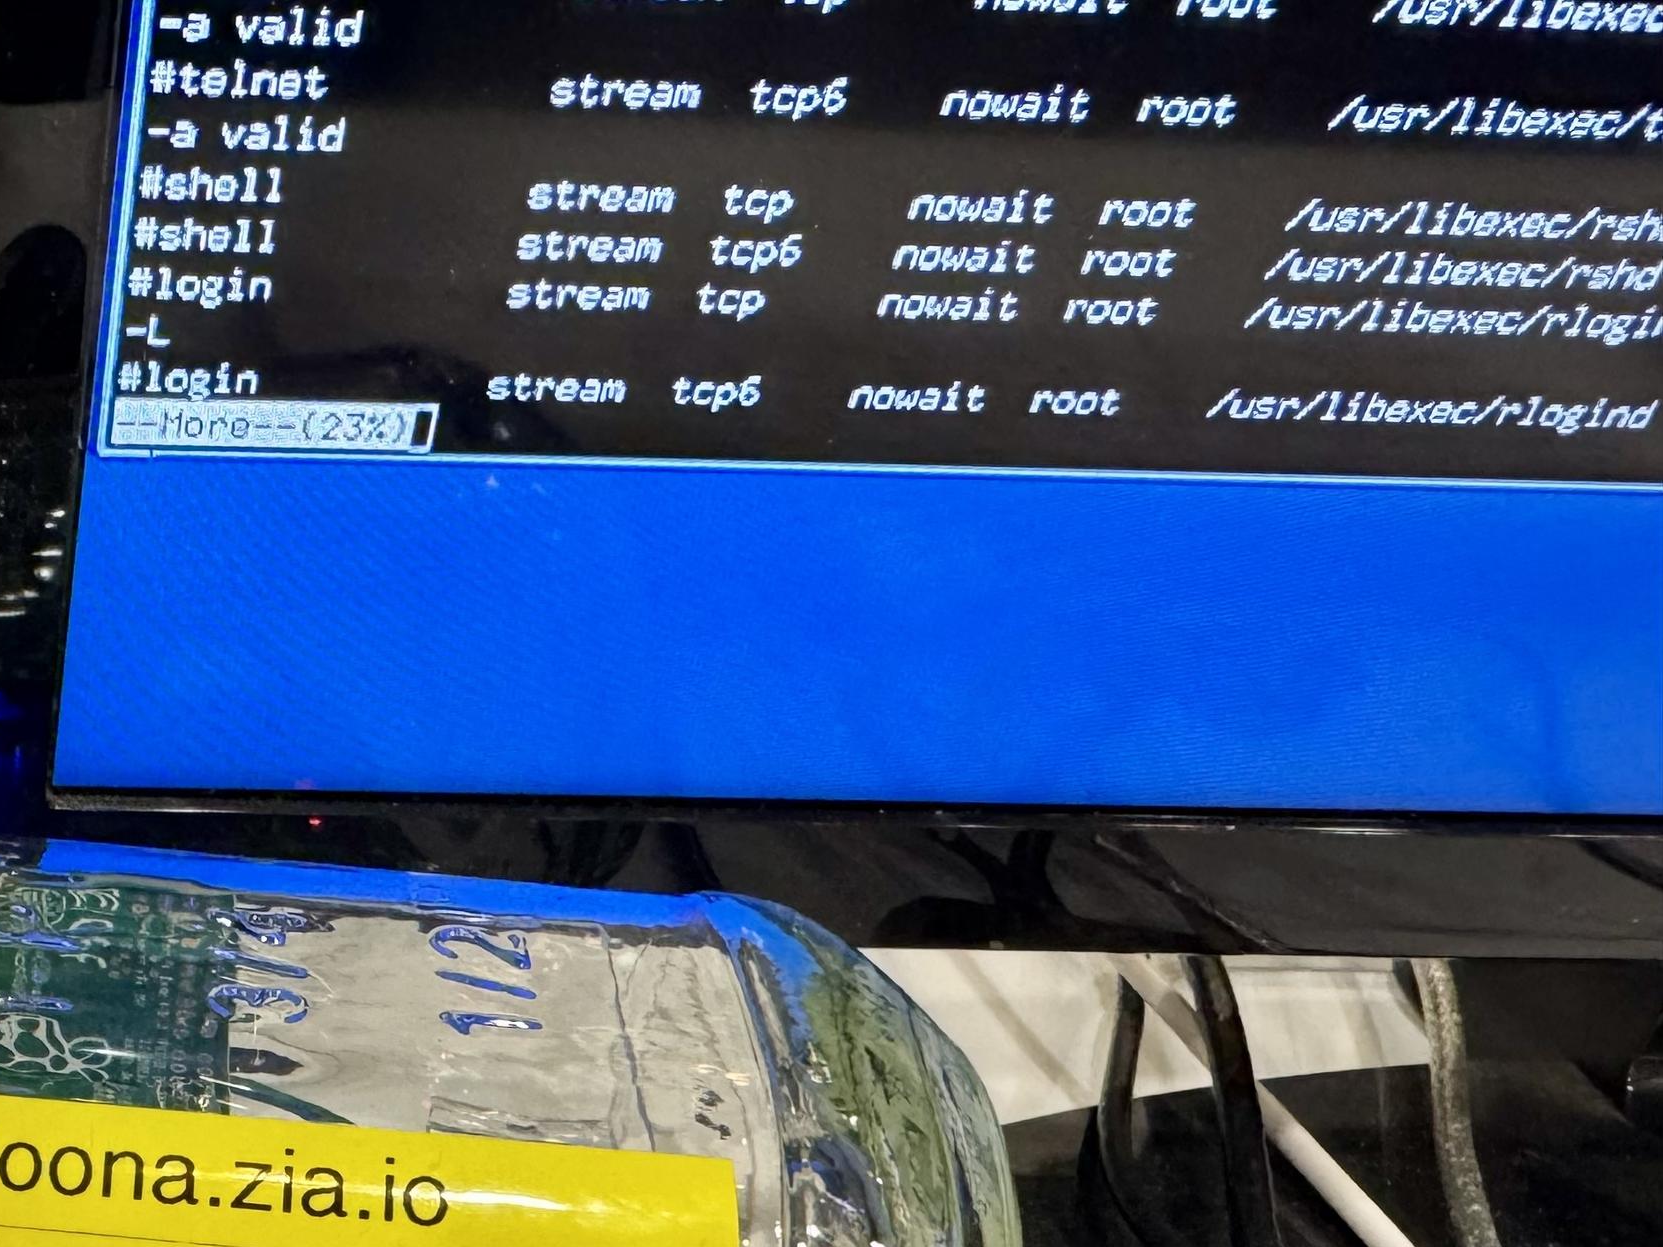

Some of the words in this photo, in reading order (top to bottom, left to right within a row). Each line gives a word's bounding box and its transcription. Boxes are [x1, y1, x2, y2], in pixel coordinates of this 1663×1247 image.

[160, 13, 210, 42] -a
[236, 6, 364, 47] valid
[150, 60, 328, 100] #telnet
[550, 74, 701, 110] stream
[750, 77, 847, 121] tcp6
[939, 84, 1090, 123] nowait
[1136, 95, 1236, 128] root
[148, 120, 199, 148] -a
[222, 115, 346, 152] valid
[139, 165, 281, 203] #shell
[527, 180, 676, 213] stream
[725, 184, 795, 224] tcp
[907, 189, 1054, 224] nowait
[1098, 198, 1197, 228] root
[134, 217, 275, 254] #shell
[517, 231, 664, 263] stream
[710, 234, 802, 273] tcp6
[892, 240, 1035, 274] nowait
[1081, 249, 1177, 277] root
[128, 266, 272, 309] #login
[506, 278, 651, 311] stream
[697, 282, 766, 321] tcp
[877, 288, 1018, 321] nowait
[1063, 297, 1159, 326] root
[126, 314, 170, 347] -L
[118, 360, 258, 400] #login
[486, 373, 627, 403] stream
[672, 375, 761, 412] tcp6
[847, 382, 985, 412] nowait
[1029, 389, 1120, 416] root
[1206, 388, 1658, 435] /usr/libexec/rlogind
